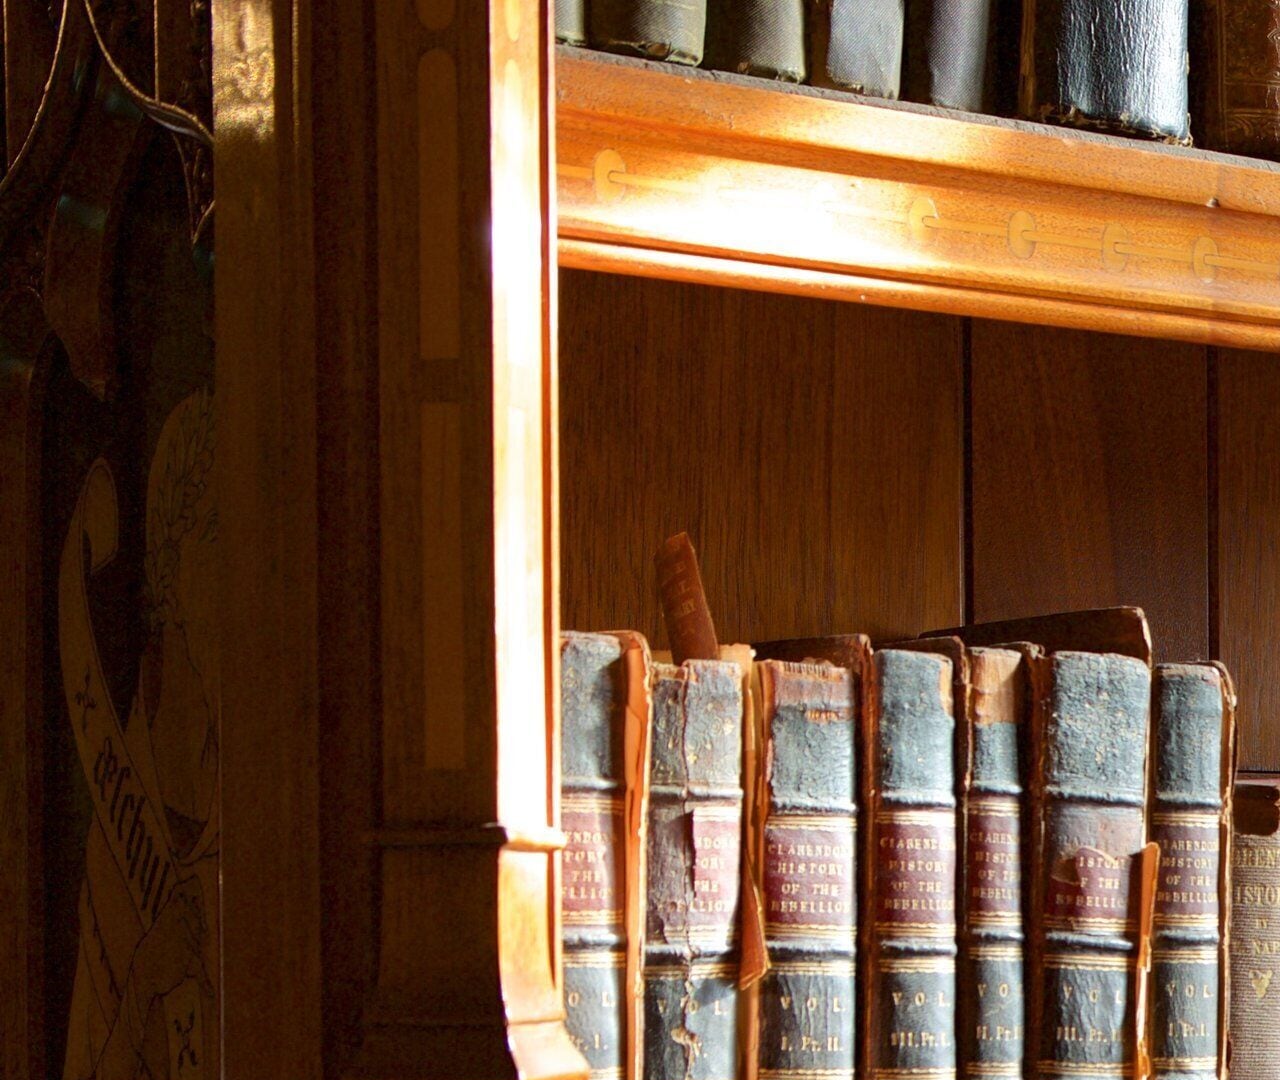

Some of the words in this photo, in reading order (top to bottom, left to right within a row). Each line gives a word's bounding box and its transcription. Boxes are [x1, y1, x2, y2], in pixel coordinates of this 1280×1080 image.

[777, 862, 845, 876] HISTORY
[918, 881, 942, 894] THE
[1098, 877, 1121, 891] THE
[1166, 874, 1182, 886] OF
[1190, 874, 1212, 887] THE
[781, 883, 800, 897] OF
[813, 883, 841, 897] THE
